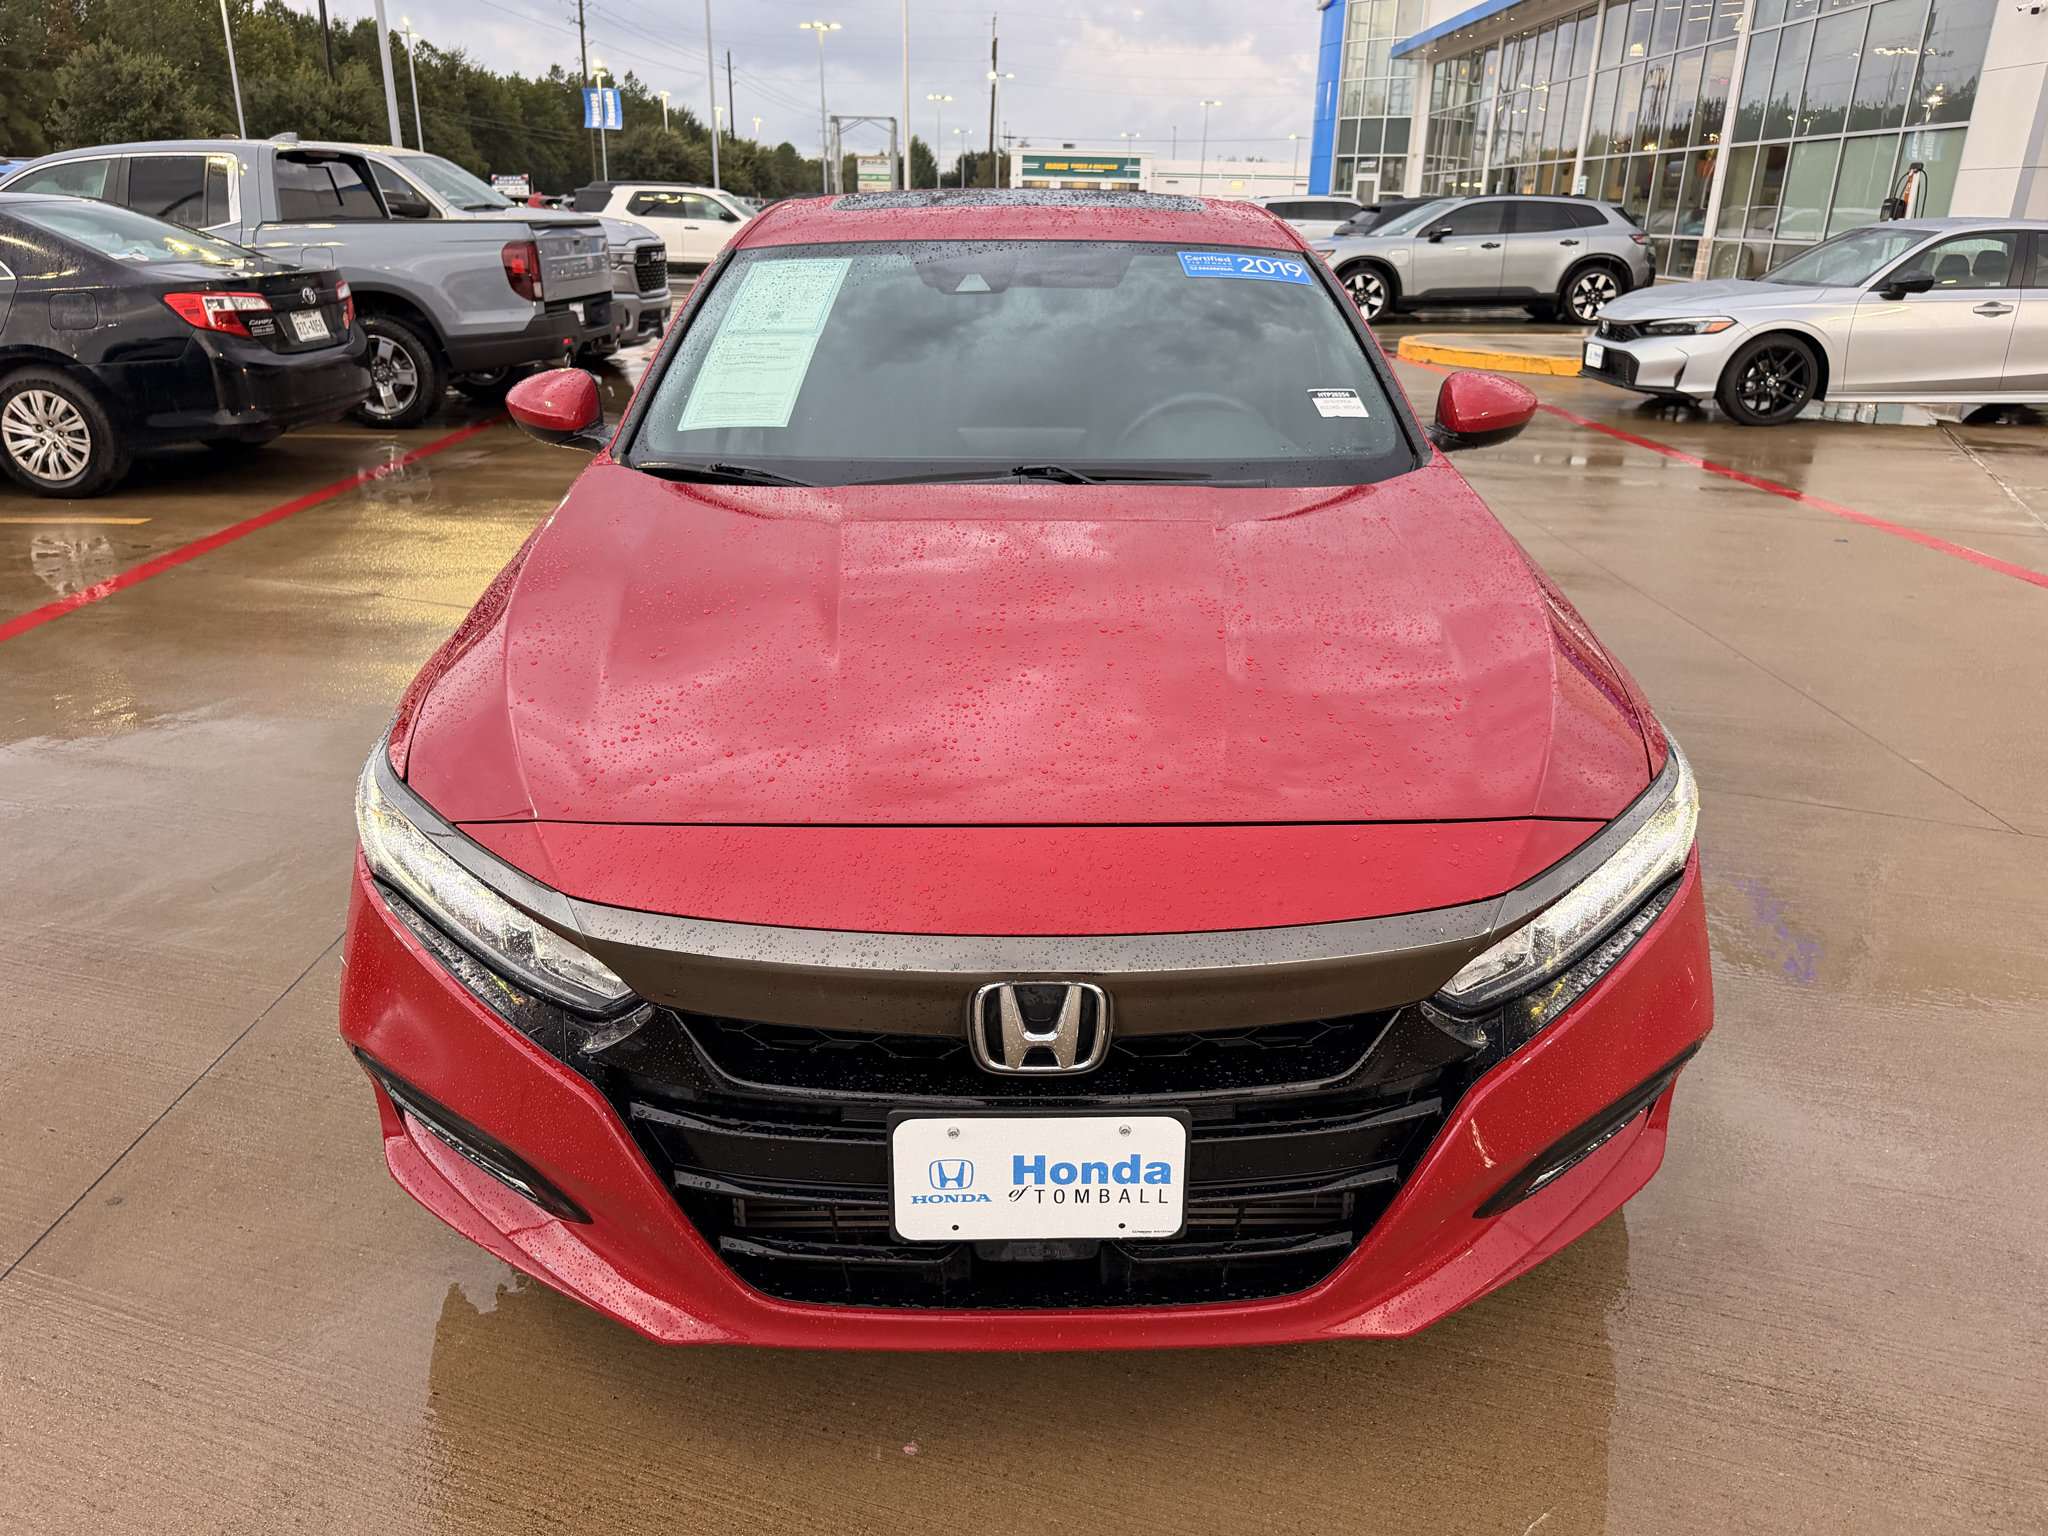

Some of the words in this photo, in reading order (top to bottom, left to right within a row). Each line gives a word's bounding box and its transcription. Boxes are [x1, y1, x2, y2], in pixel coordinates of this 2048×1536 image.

[1237, 257, 1303, 278] 2019
[1013, 1154, 1172, 1185] Honda
[911, 1193, 993, 1204] HONDA
[1008, 1185, 1033, 1203] of
[1034, 1188, 1168, 1204] TOMBALL
